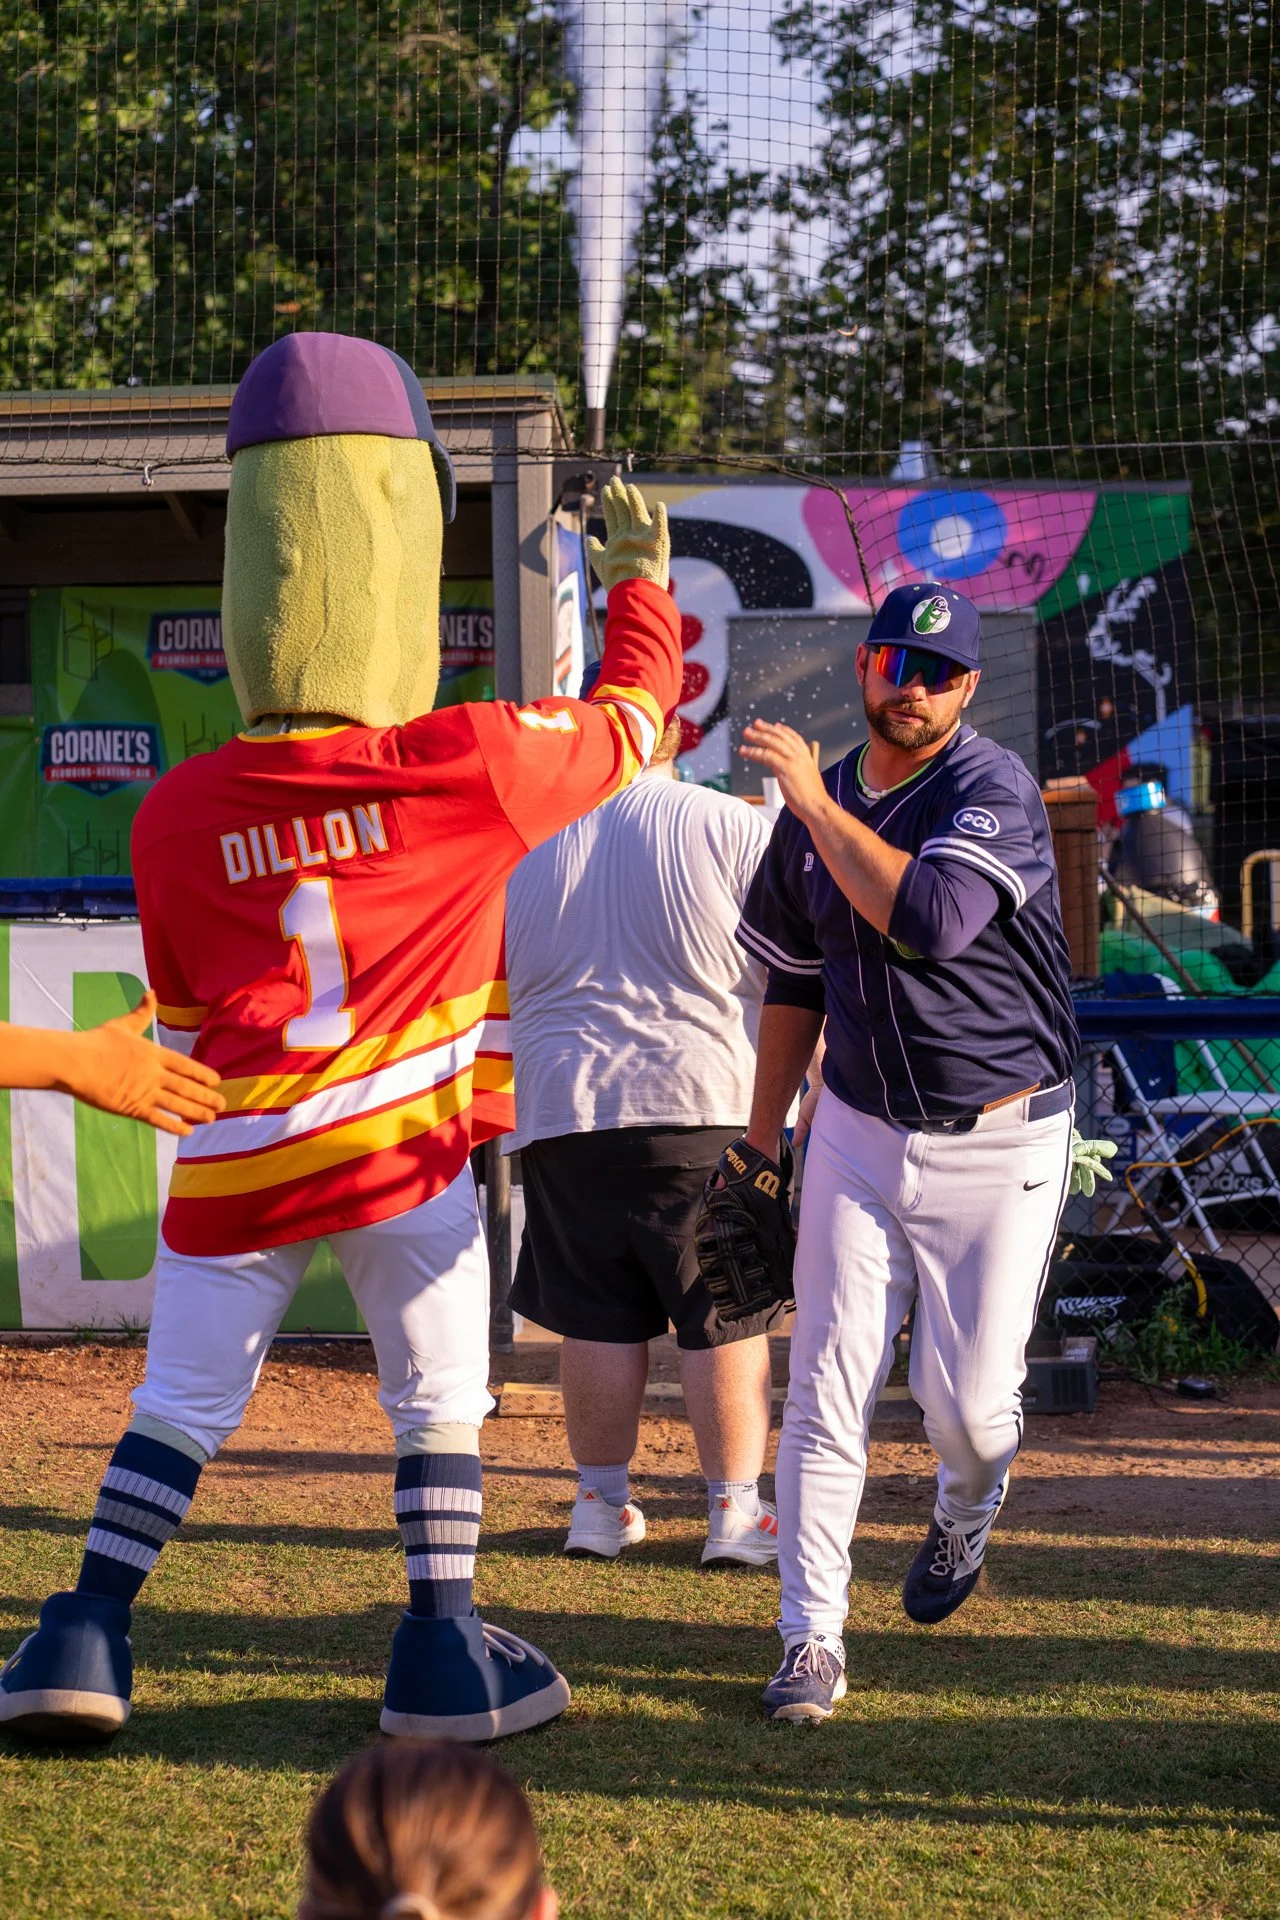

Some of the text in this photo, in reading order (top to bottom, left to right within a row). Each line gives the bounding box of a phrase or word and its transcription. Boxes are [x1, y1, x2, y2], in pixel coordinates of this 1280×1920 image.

[158, 618, 222, 651] CORN
[440, 614, 494, 648] NEL'S
[50, 730, 151, 764] CORNEL'S
[959, 812, 993, 832] PCL
[220, 802, 390, 884] DILLON
[278, 876, 356, 1052] 1
[753, 1169, 780, 1200] W
